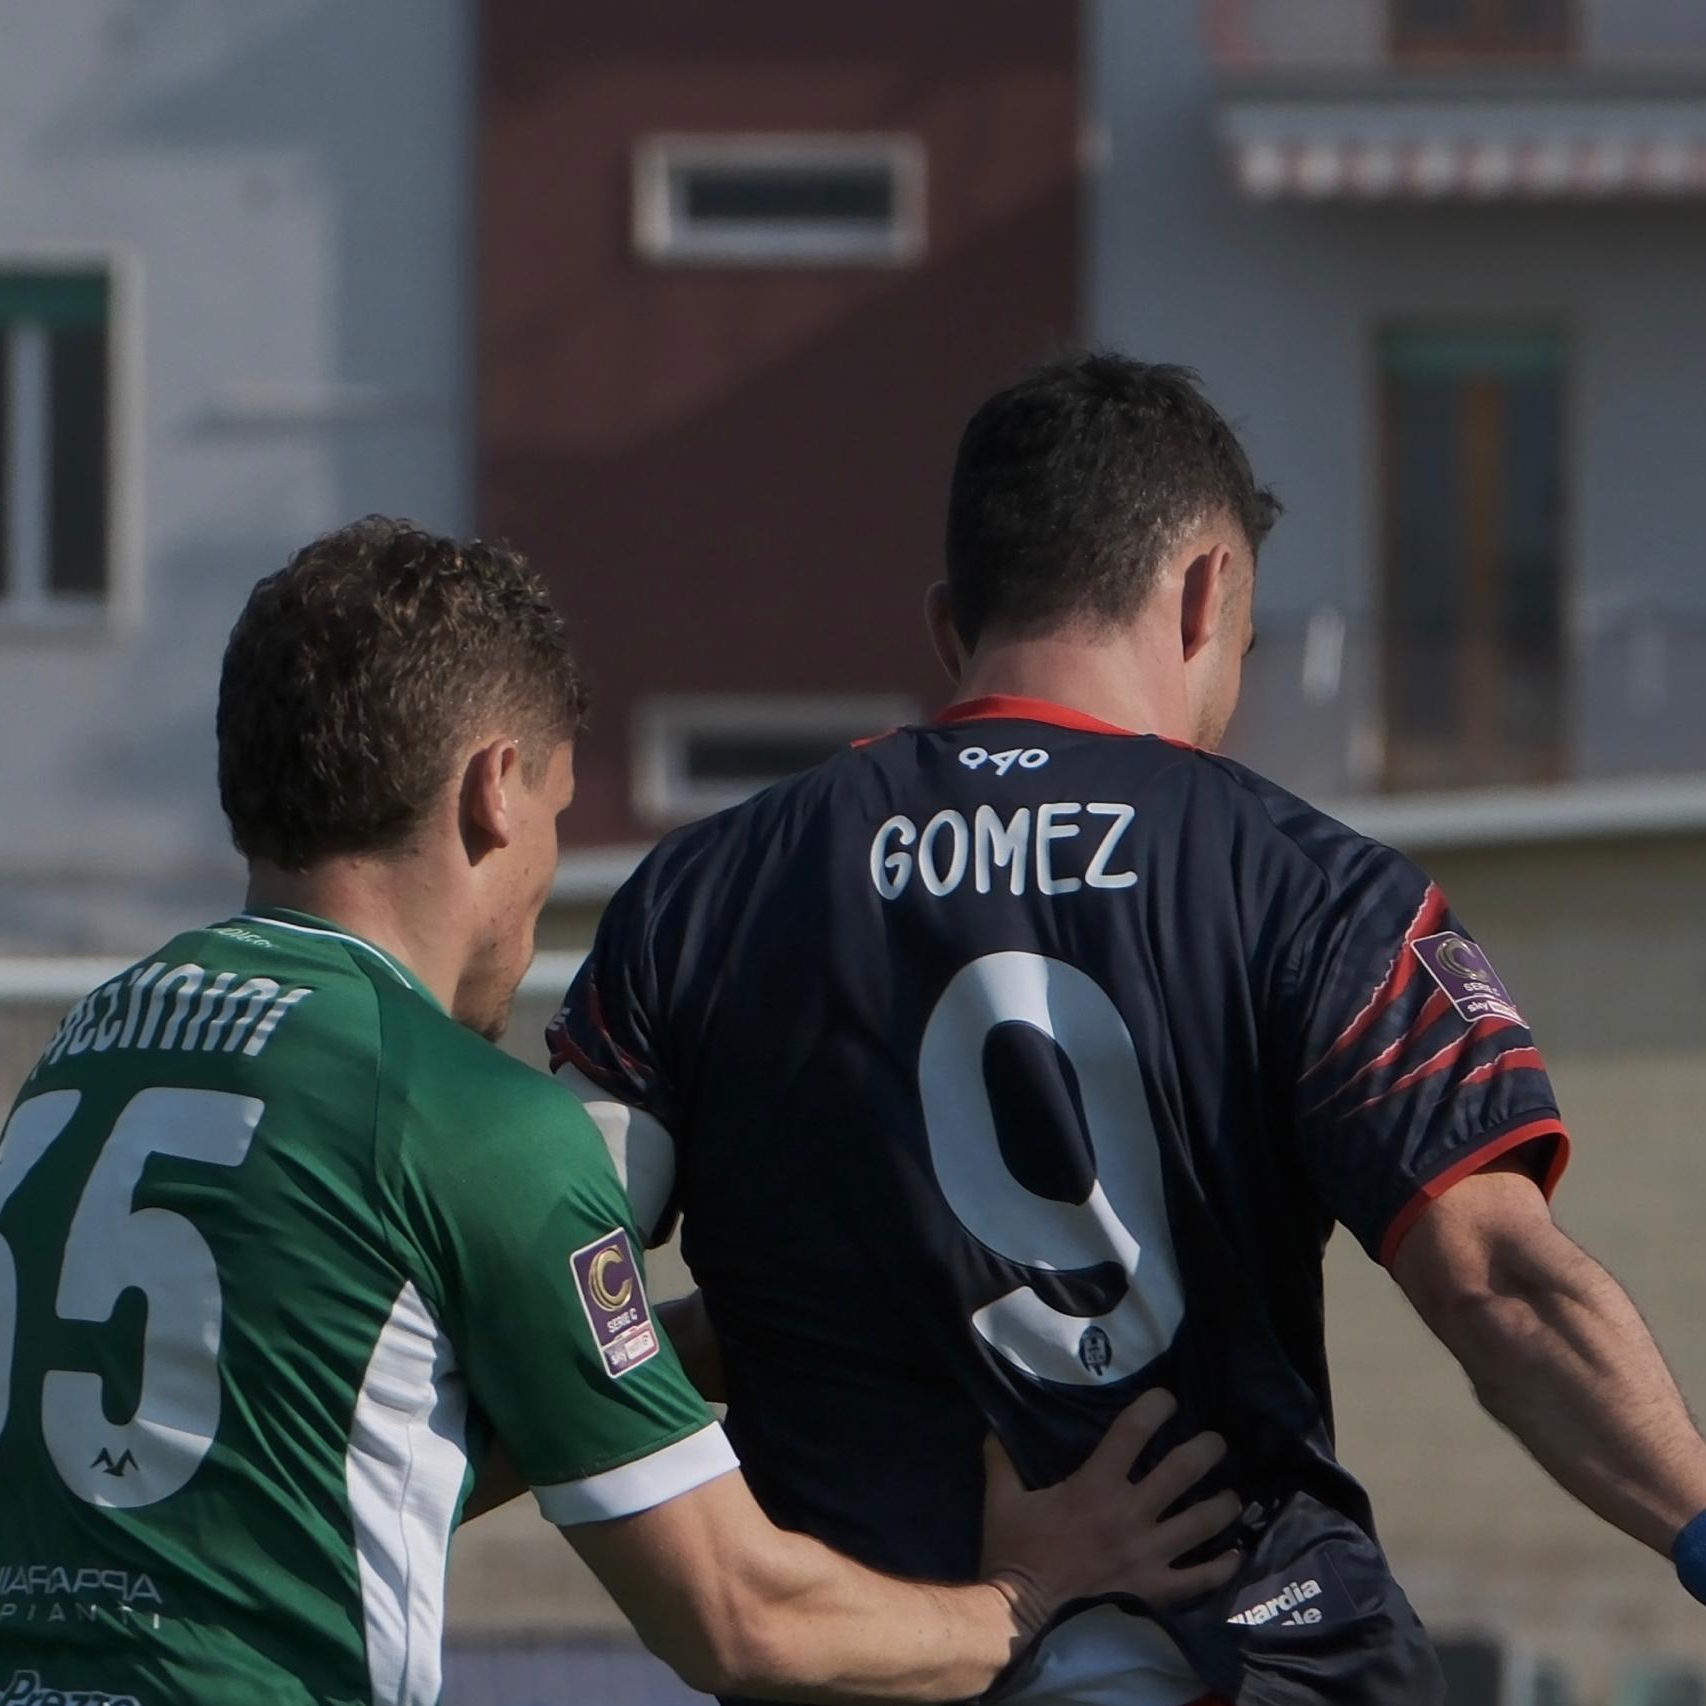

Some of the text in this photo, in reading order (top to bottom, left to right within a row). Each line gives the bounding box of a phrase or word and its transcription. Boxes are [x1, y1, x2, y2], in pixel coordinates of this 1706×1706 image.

[869, 802, 1138, 900] GOMEZ
[917, 950, 1186, 1388] 9
[1226, 1580, 1323, 1626] uardia
